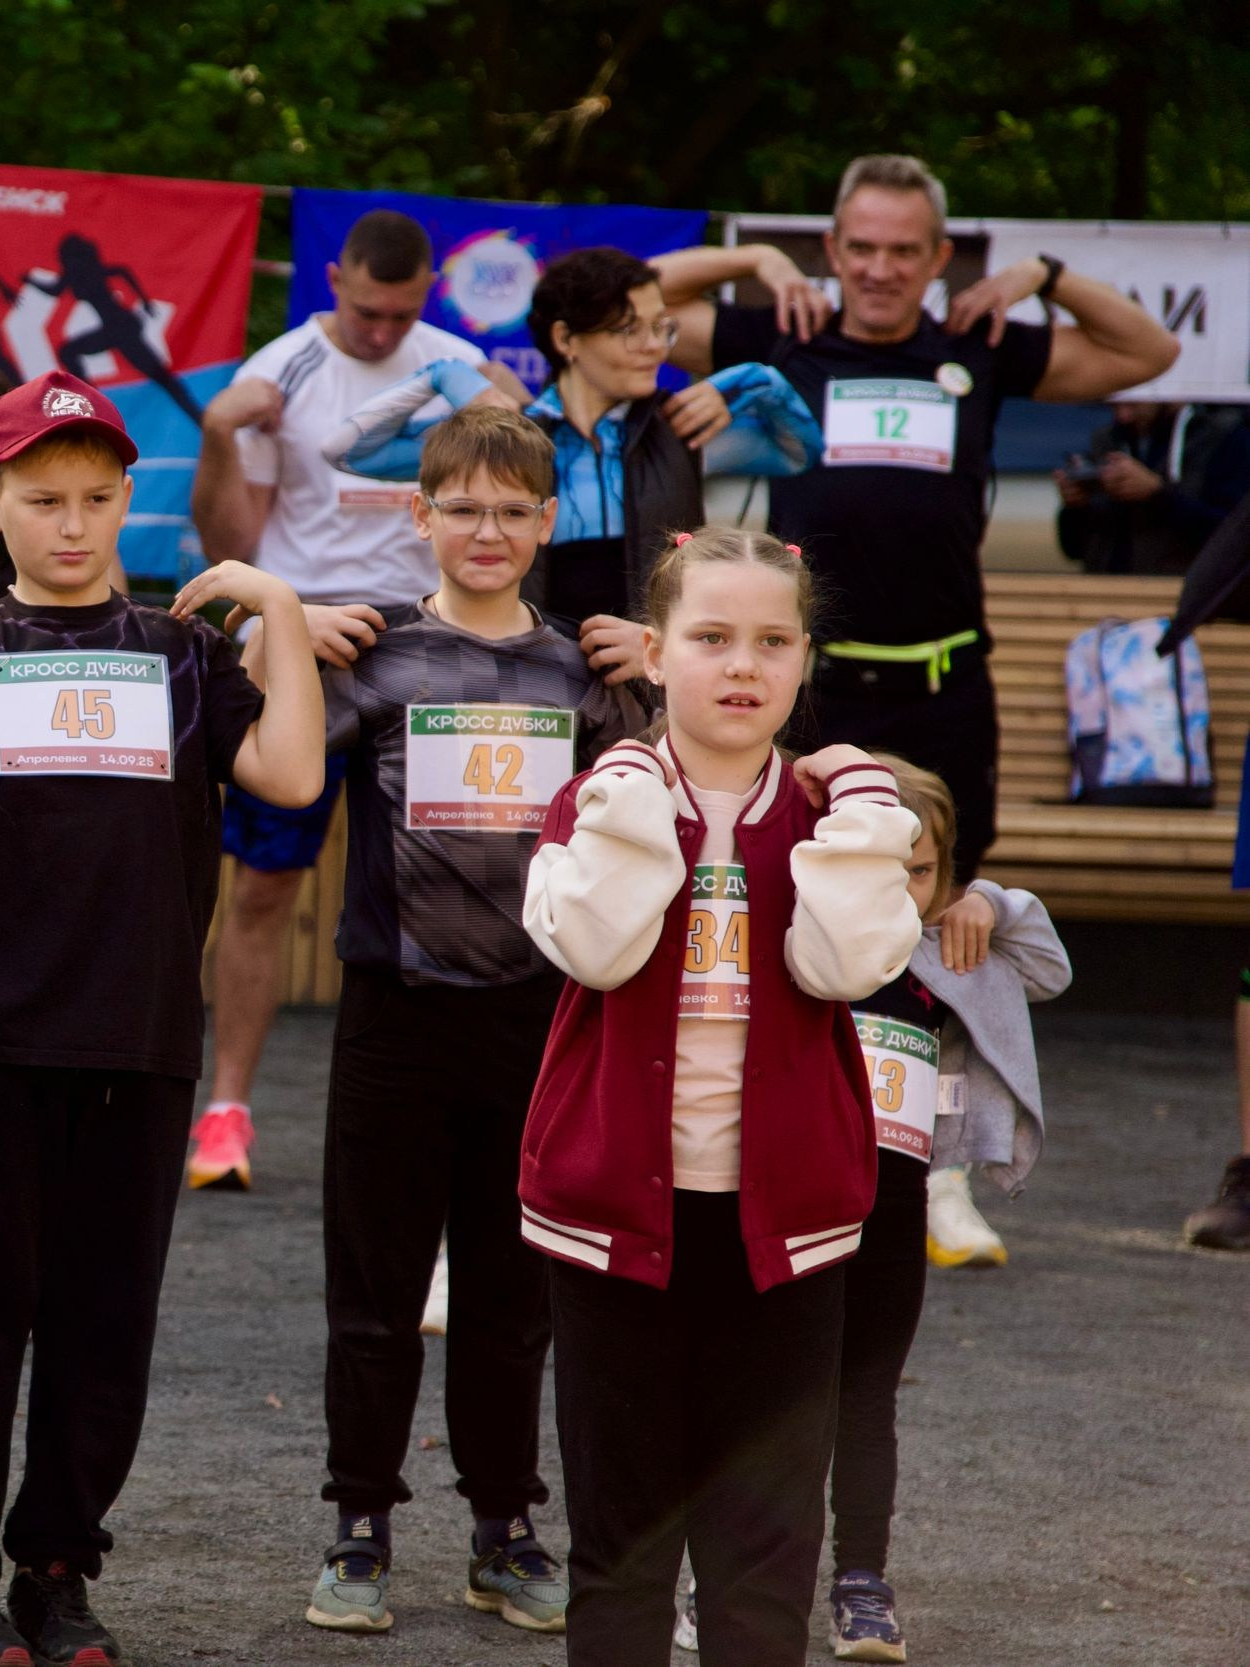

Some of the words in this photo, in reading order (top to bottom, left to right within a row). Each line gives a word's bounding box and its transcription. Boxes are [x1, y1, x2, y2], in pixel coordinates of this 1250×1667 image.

[872, 404, 910, 440] 12
[9, 662, 80, 678] КРОСС
[84, 661, 148, 678] ДУБКИ
[50, 688, 116, 740] 45
[426, 714, 495, 730] КРОСС
[498, 715, 559, 733] ДУБКИ
[16, 754, 88, 766] Апрелевка
[99, 754, 155, 767] 14.09.25
[463, 743, 525, 796] 42
[425, 809, 495, 821] Апрелевка
[683, 908, 750, 975] 34
[886, 1030, 933, 1058] ДУБКИ
[882, 1126, 924, 1150] 14.09.25
